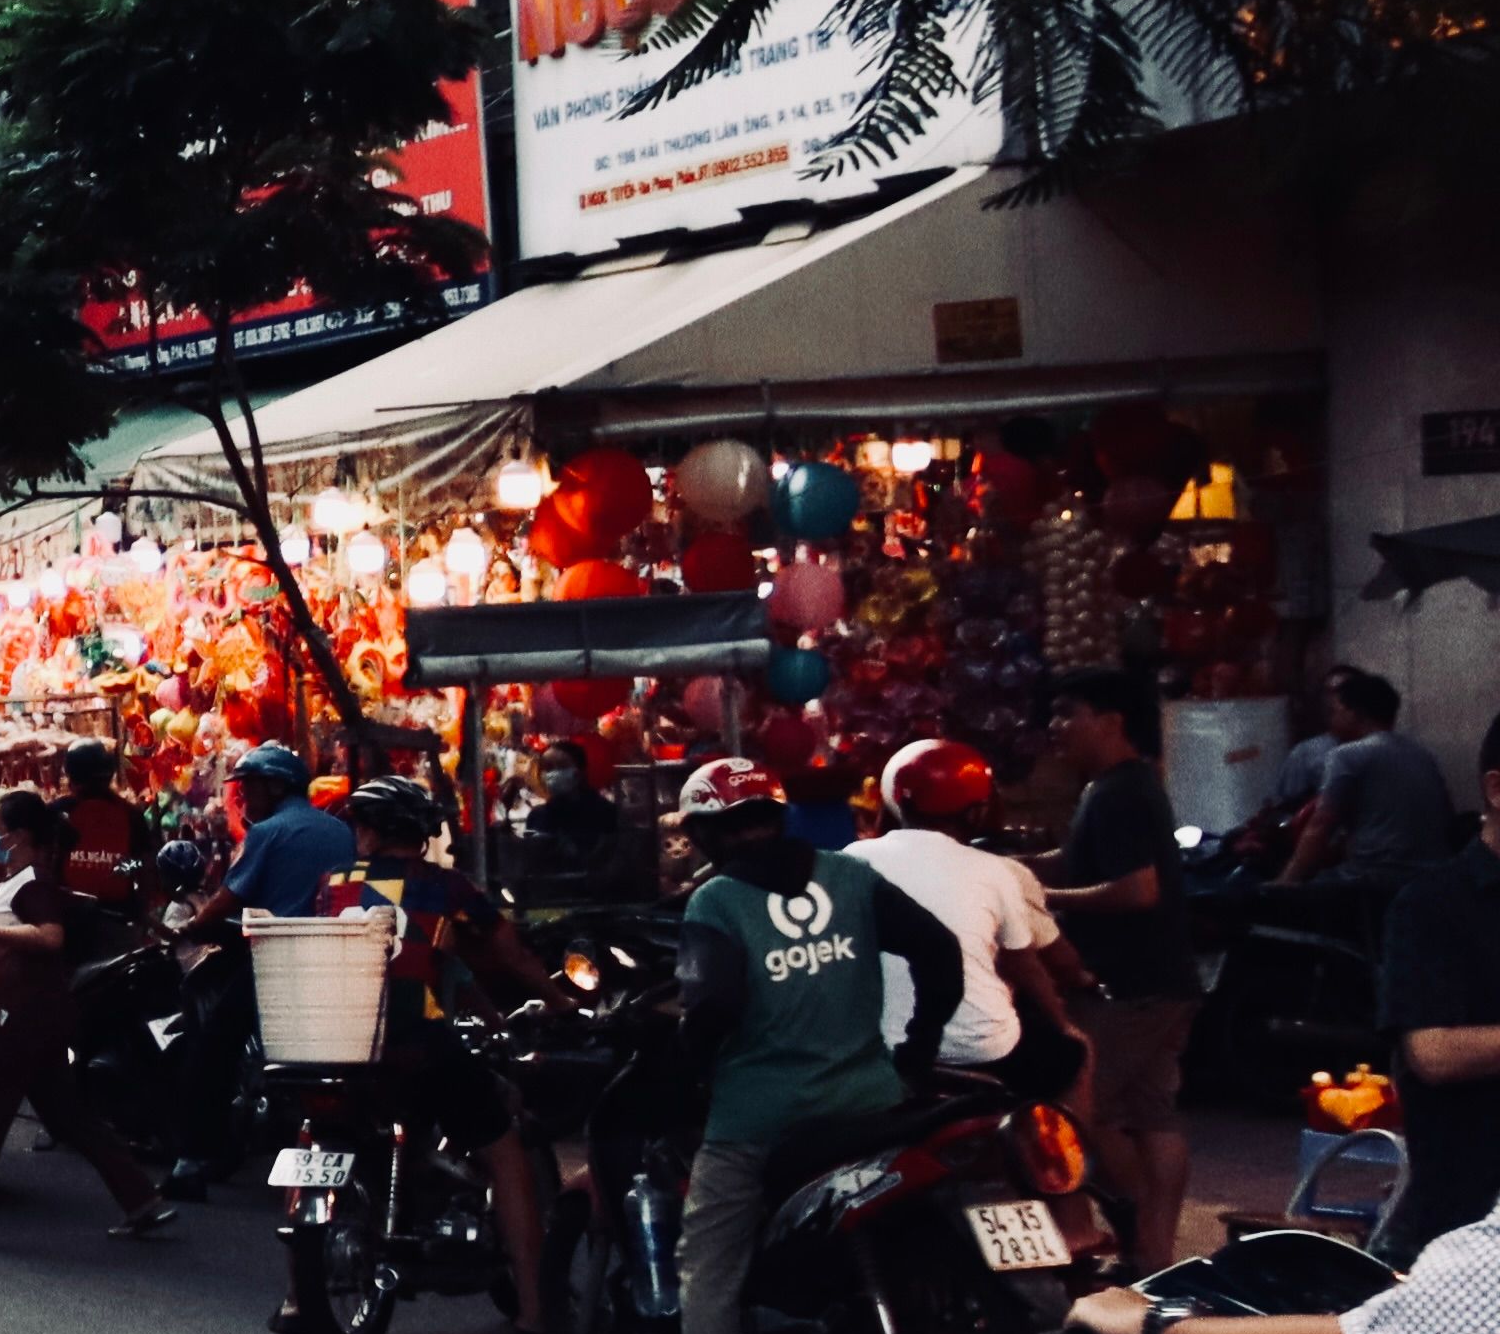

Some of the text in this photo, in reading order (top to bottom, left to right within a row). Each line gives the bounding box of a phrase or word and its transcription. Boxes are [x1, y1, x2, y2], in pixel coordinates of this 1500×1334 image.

[749, 35, 799, 69] TRANG
[420, 189, 452, 215] THU
[765, 933, 856, 982] gojek
